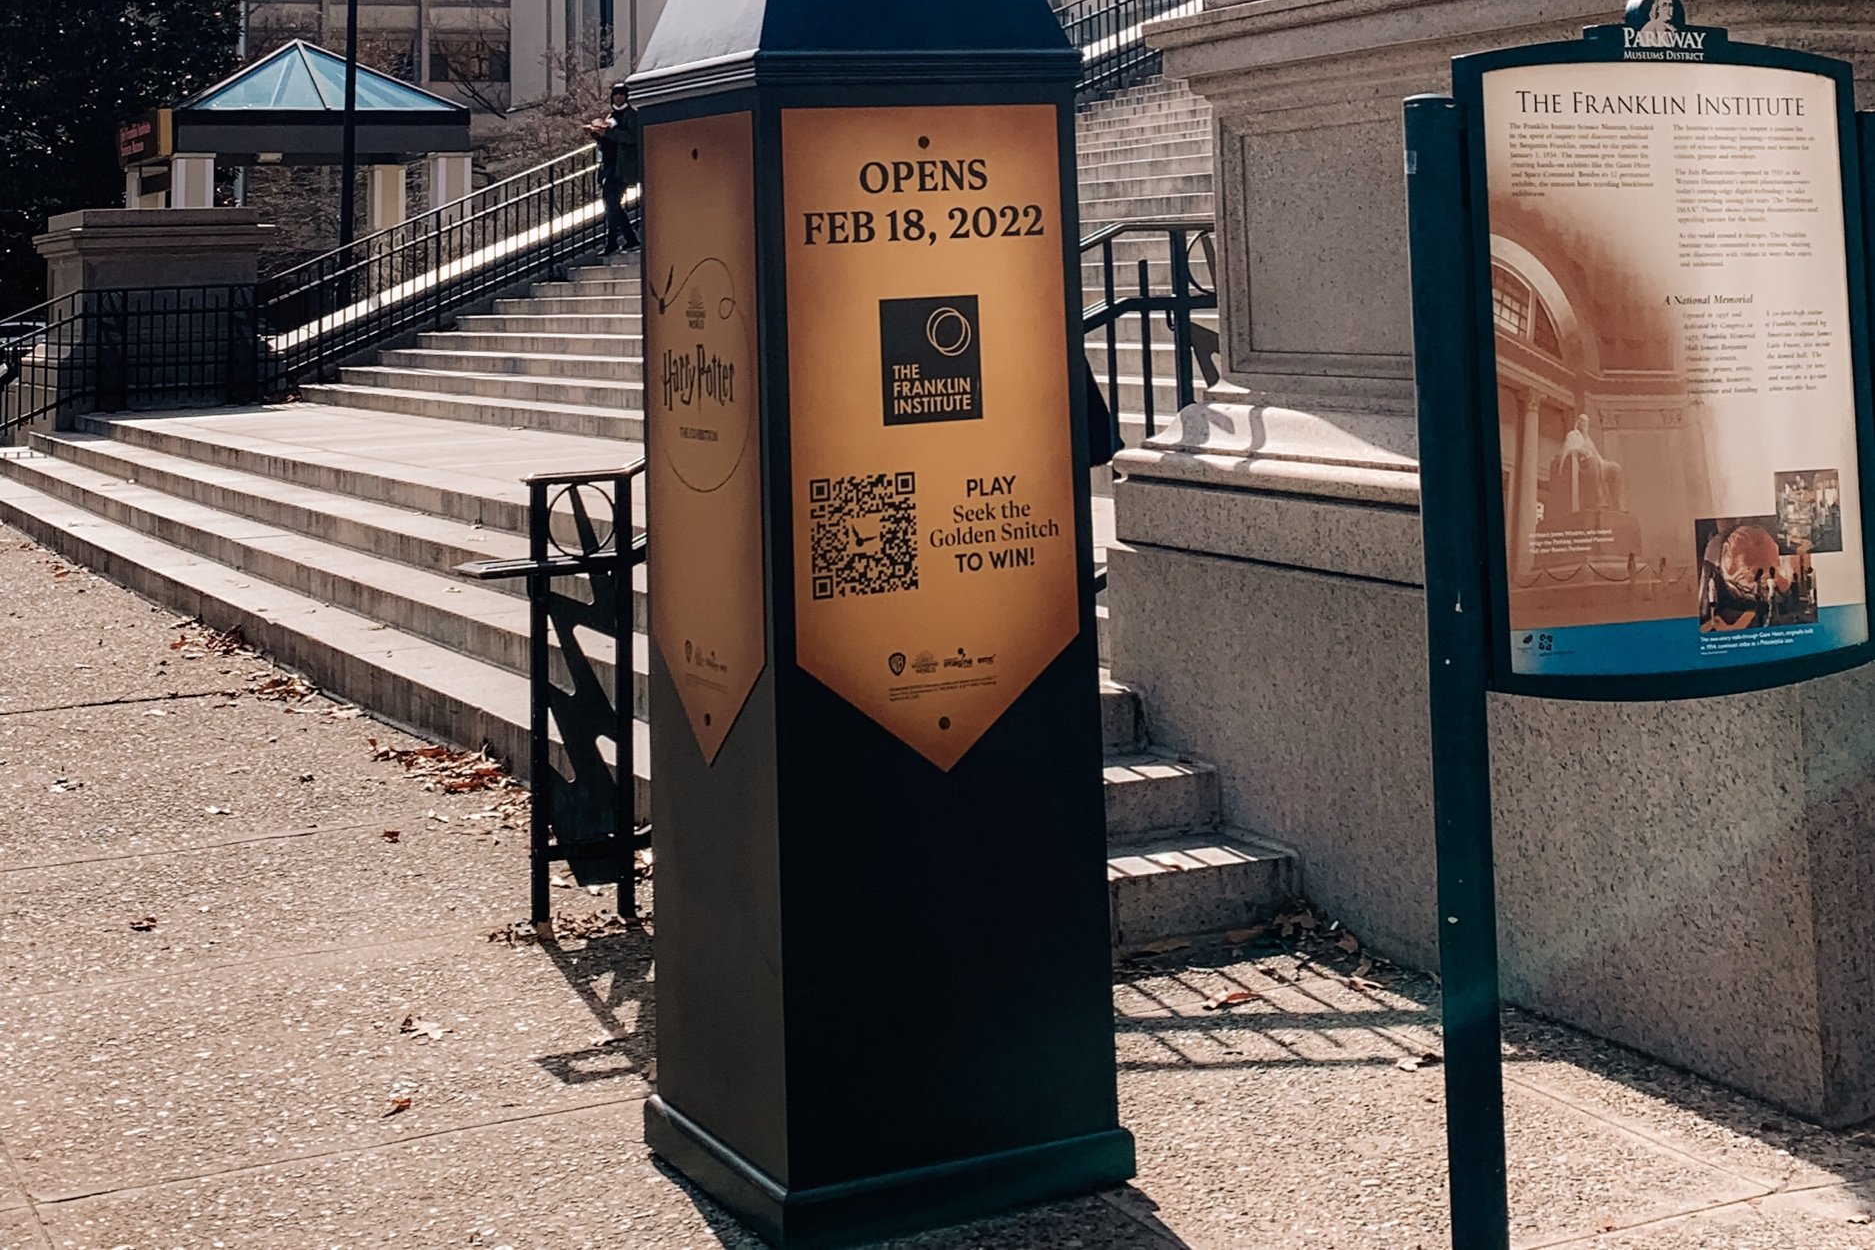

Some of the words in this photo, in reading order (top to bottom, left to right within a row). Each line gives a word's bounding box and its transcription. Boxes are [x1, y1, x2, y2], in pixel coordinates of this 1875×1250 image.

[1622, 27, 1706, 49] PARKWAY
[1624, 50, 1664, 60] MUSEUMS
[1666, 50, 1704, 61] DISTRICT
[1515, 90, 1562, 114] THE
[1572, 91, 1686, 115] FRANKLIN
[1696, 93, 1805, 116] INSTITUTE
[859, 158, 988, 194] OPENS
[803, 211, 876, 245] FEB
[886, 208, 937, 246] 18,
[948, 204, 1044, 240] 2022
[1673, 295, 1710, 305] National
[1713, 293, 1753, 304] Memorial
[662, 348, 696, 412] Harry
[696, 343, 735, 410] Potter
[892, 363, 920, 380] THE
[893, 376, 971, 398] FRANKLIN
[893, 394, 972, 415] INSTITUTE
[966, 475, 1017, 498] PLAY
[953, 502, 997, 524] Seek
[1001, 500, 1031, 519] the
[929, 526, 996, 548] Golden
[1001, 518, 1060, 541] Snitch
[954, 552, 983, 573] TO
[988, 547, 1035, 569] WIN!
